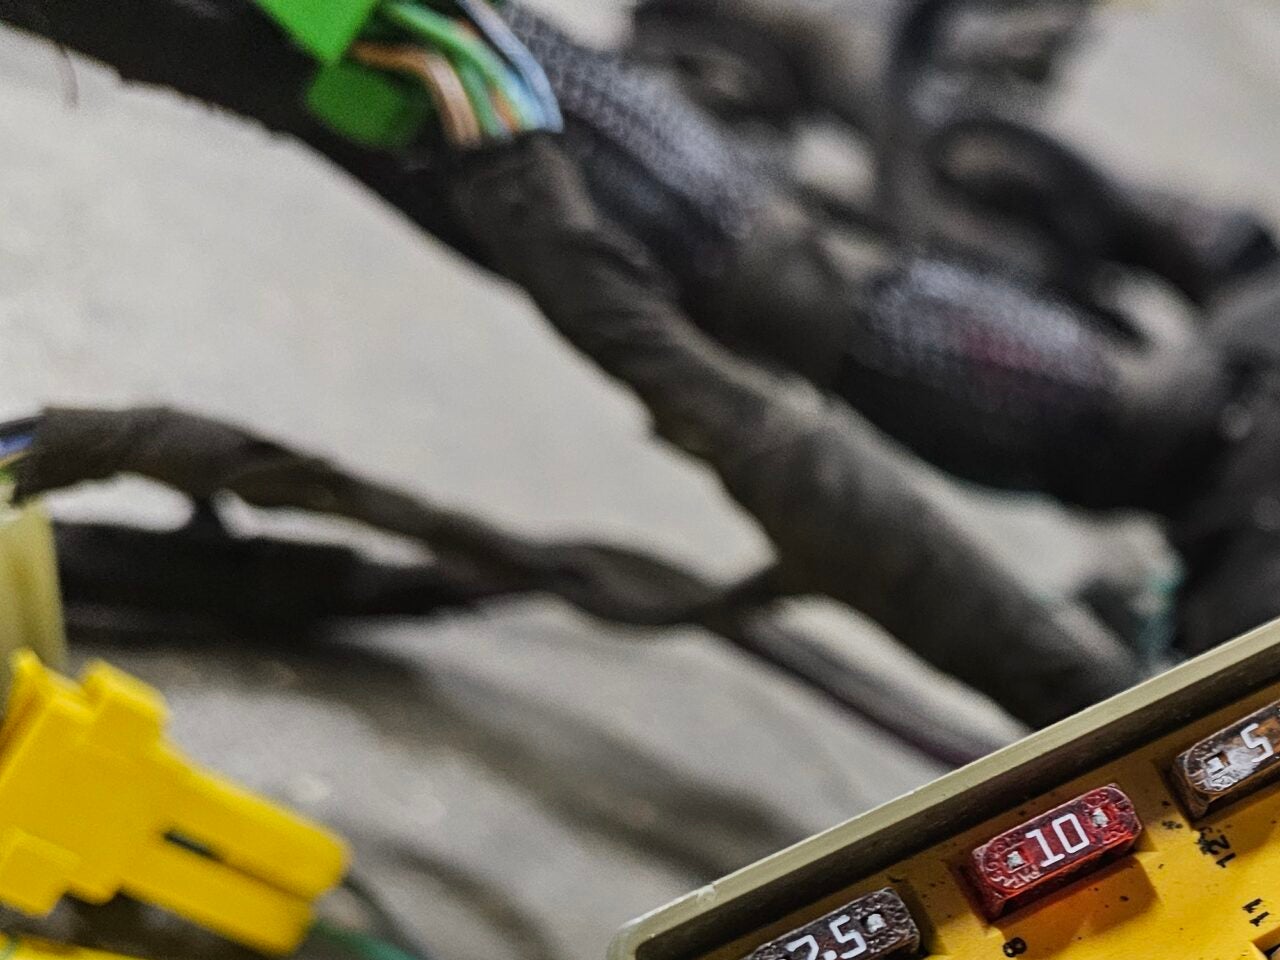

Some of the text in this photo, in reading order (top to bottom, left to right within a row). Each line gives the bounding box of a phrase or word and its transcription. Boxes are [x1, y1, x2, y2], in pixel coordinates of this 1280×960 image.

[1241, 723, 1273, 762] 5
[1026, 813, 1090, 868] 10
[1003, 936, 1027, 958] 8
